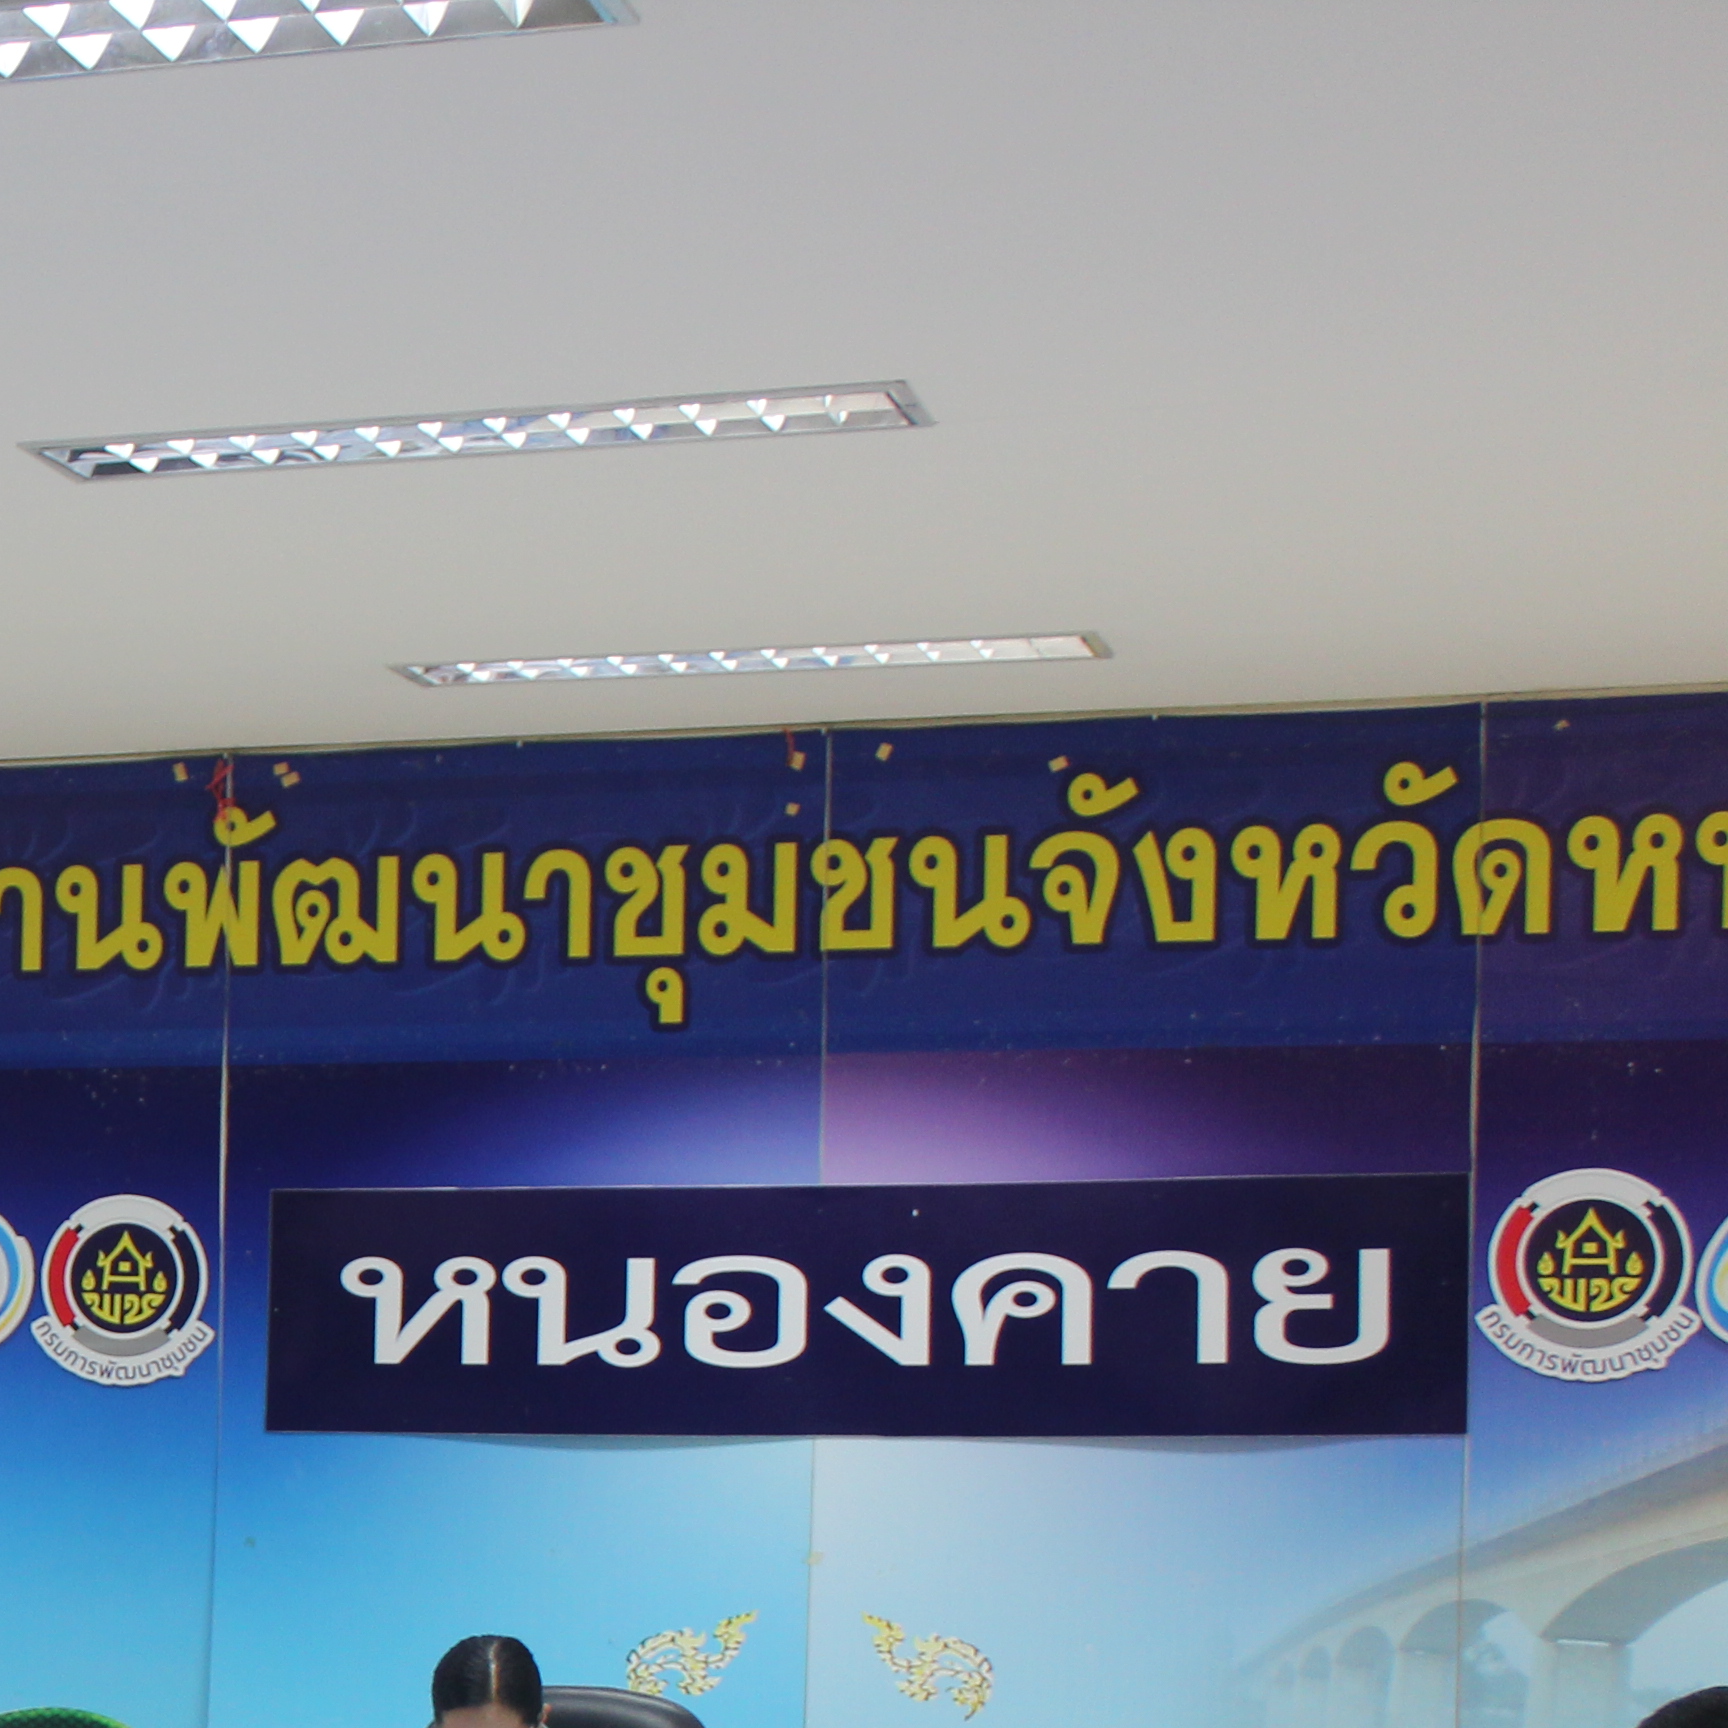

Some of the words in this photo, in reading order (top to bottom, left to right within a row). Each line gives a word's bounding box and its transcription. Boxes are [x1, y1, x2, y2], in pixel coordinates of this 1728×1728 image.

[340, 1247, 1392, 1368] หนองคาย
[36, 1320, 209, 1381] กรมการพัฒนาชุมชน
[1482, 1310, 1695, 1376] กรมการพัฒนาชุมชน
